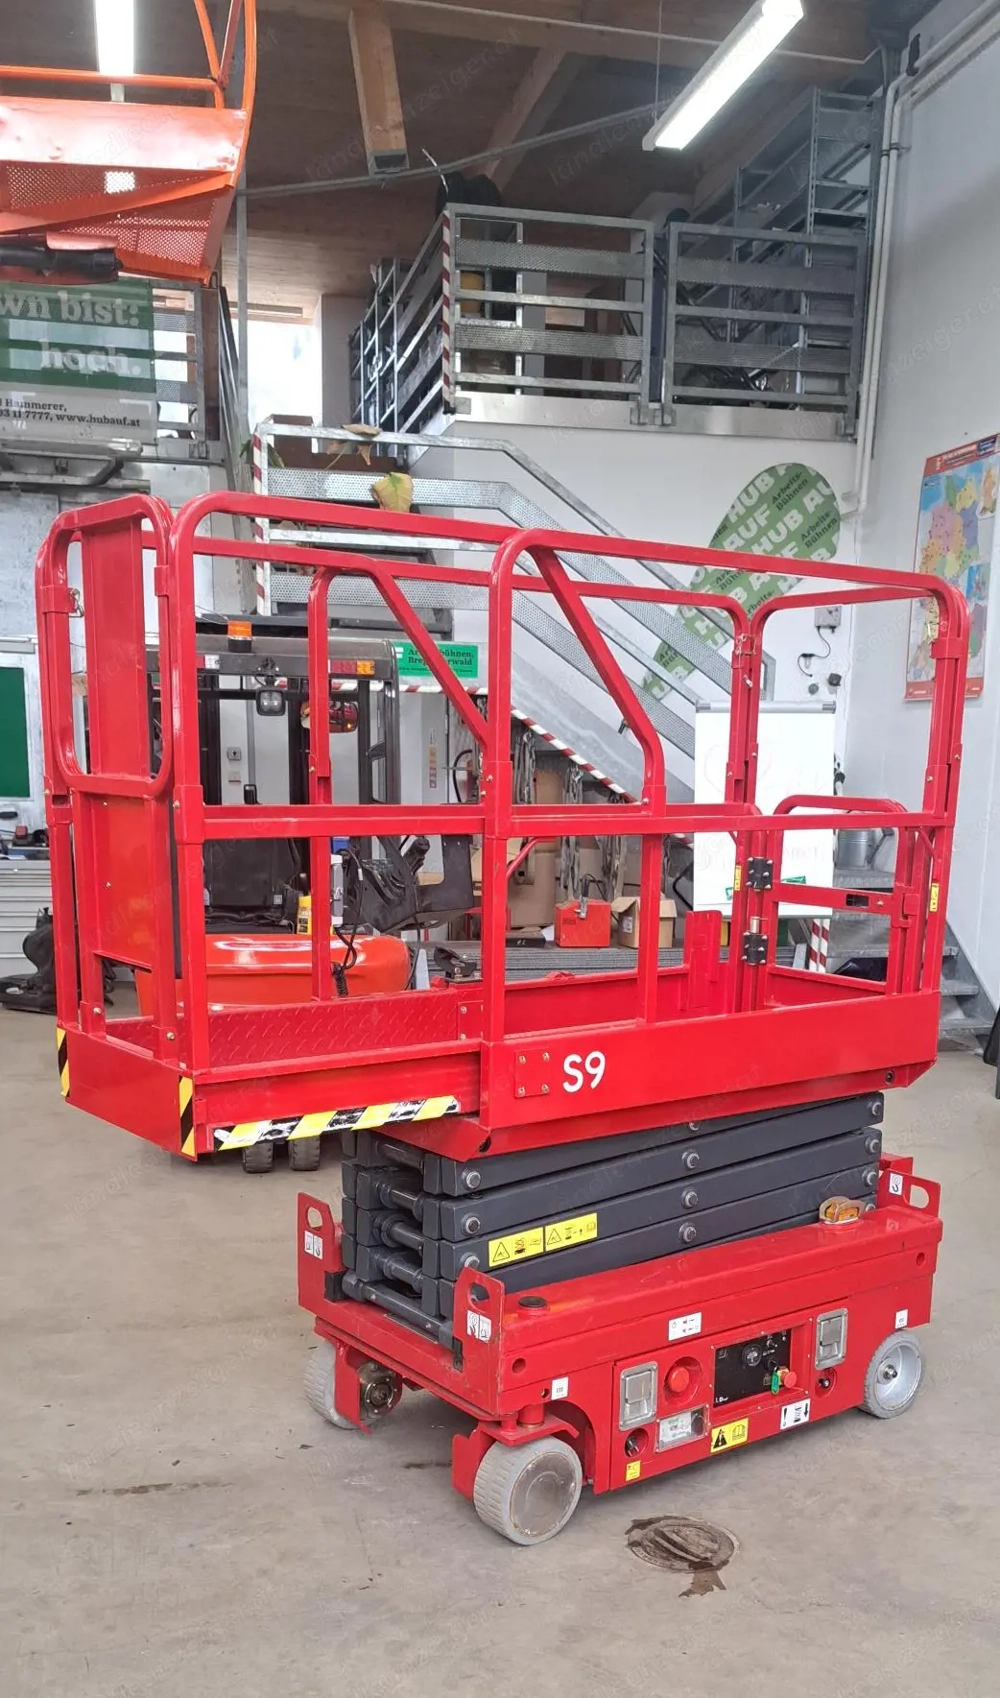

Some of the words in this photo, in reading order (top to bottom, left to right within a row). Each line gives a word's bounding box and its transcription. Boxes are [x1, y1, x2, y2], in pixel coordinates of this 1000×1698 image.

[57, 289, 140, 327] bist:
[39, 339, 142, 376] hoch.
[25, 411, 53, 422] 7777,
[55, 413, 140, 427] www.hubauf.at
[775, 477, 808, 511] Bühnen
[562, 1050, 606, 1093] S9
